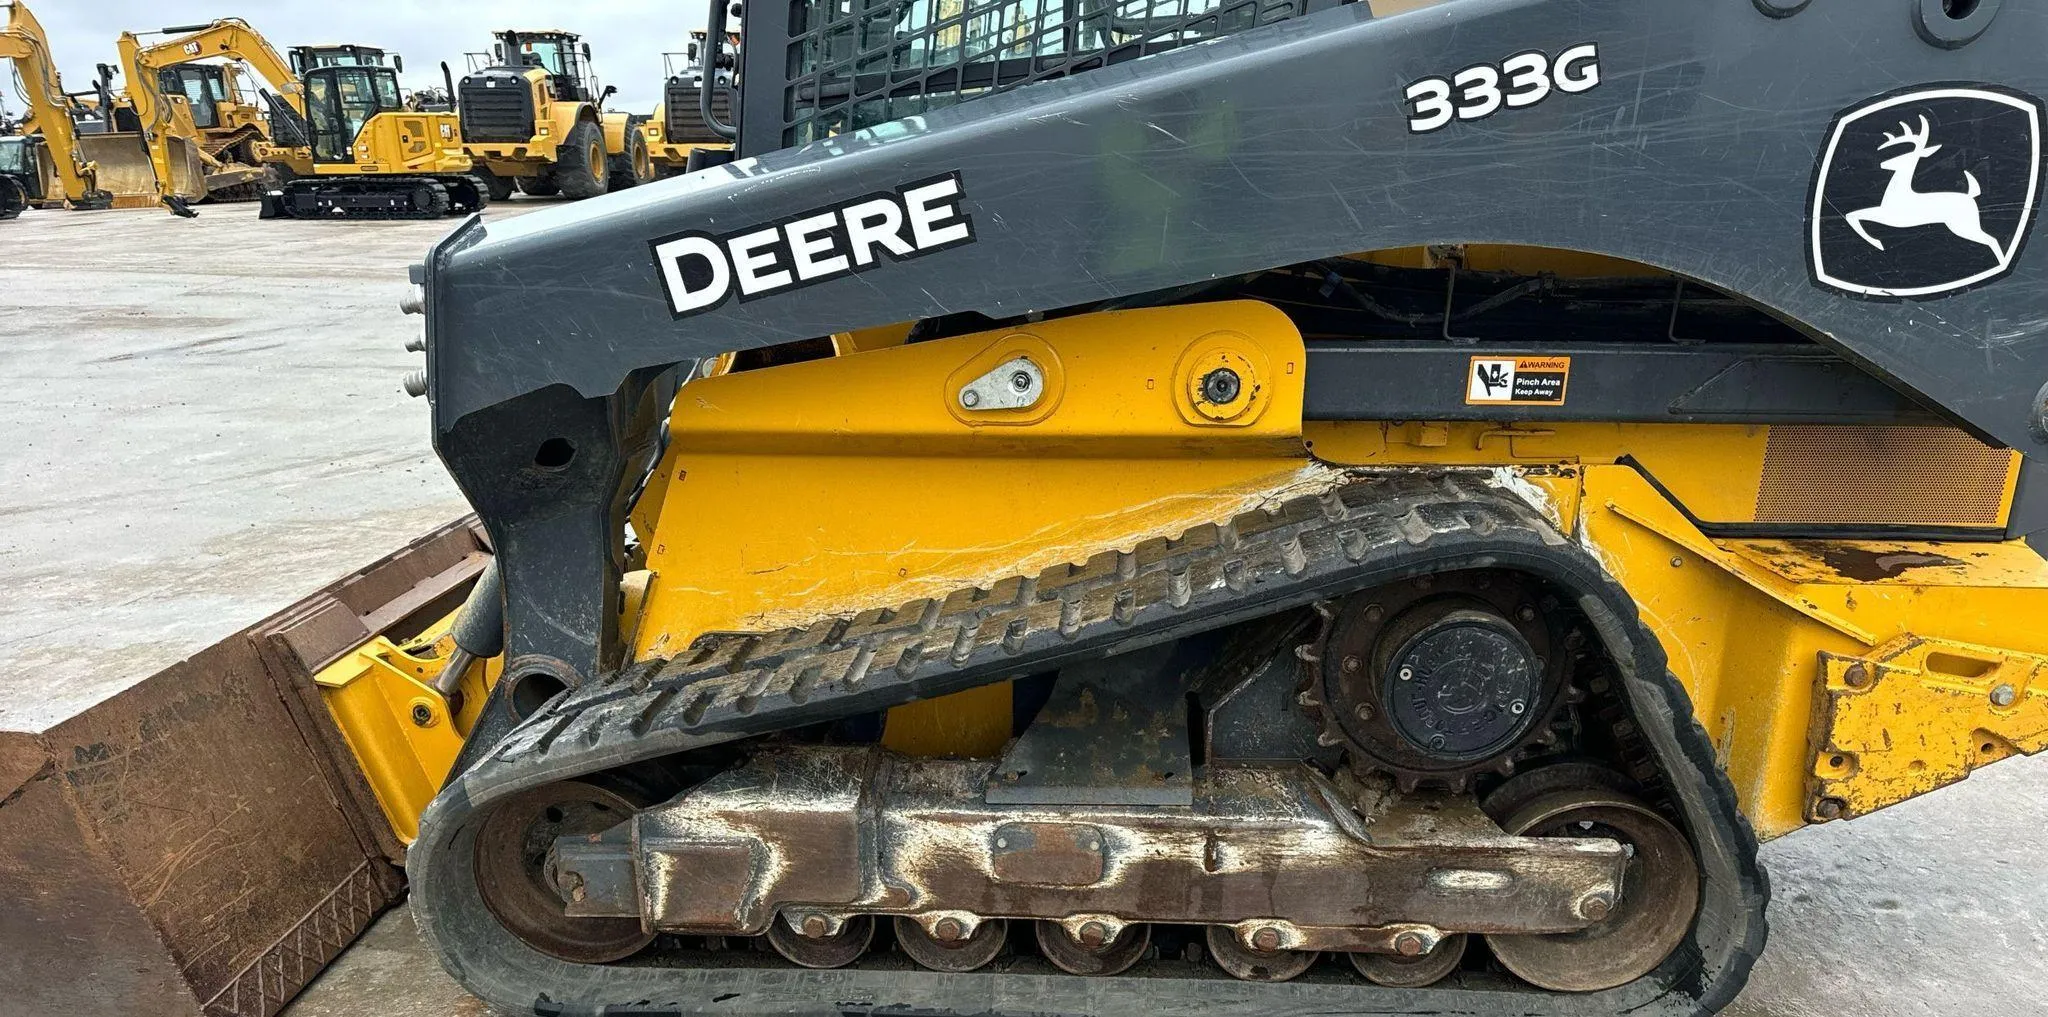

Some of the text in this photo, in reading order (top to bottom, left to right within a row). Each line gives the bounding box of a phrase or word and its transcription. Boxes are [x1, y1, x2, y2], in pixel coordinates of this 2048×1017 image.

[183, 41, 199, 55] CAT
[1406, 44, 1599, 132] 333G
[655, 178, 969, 313] DEERE
[1527, 361, 1565, 369] WARNING
[1516, 378, 1561, 386] Pinch Area
[1514, 388, 1554, 397] Keep Away
